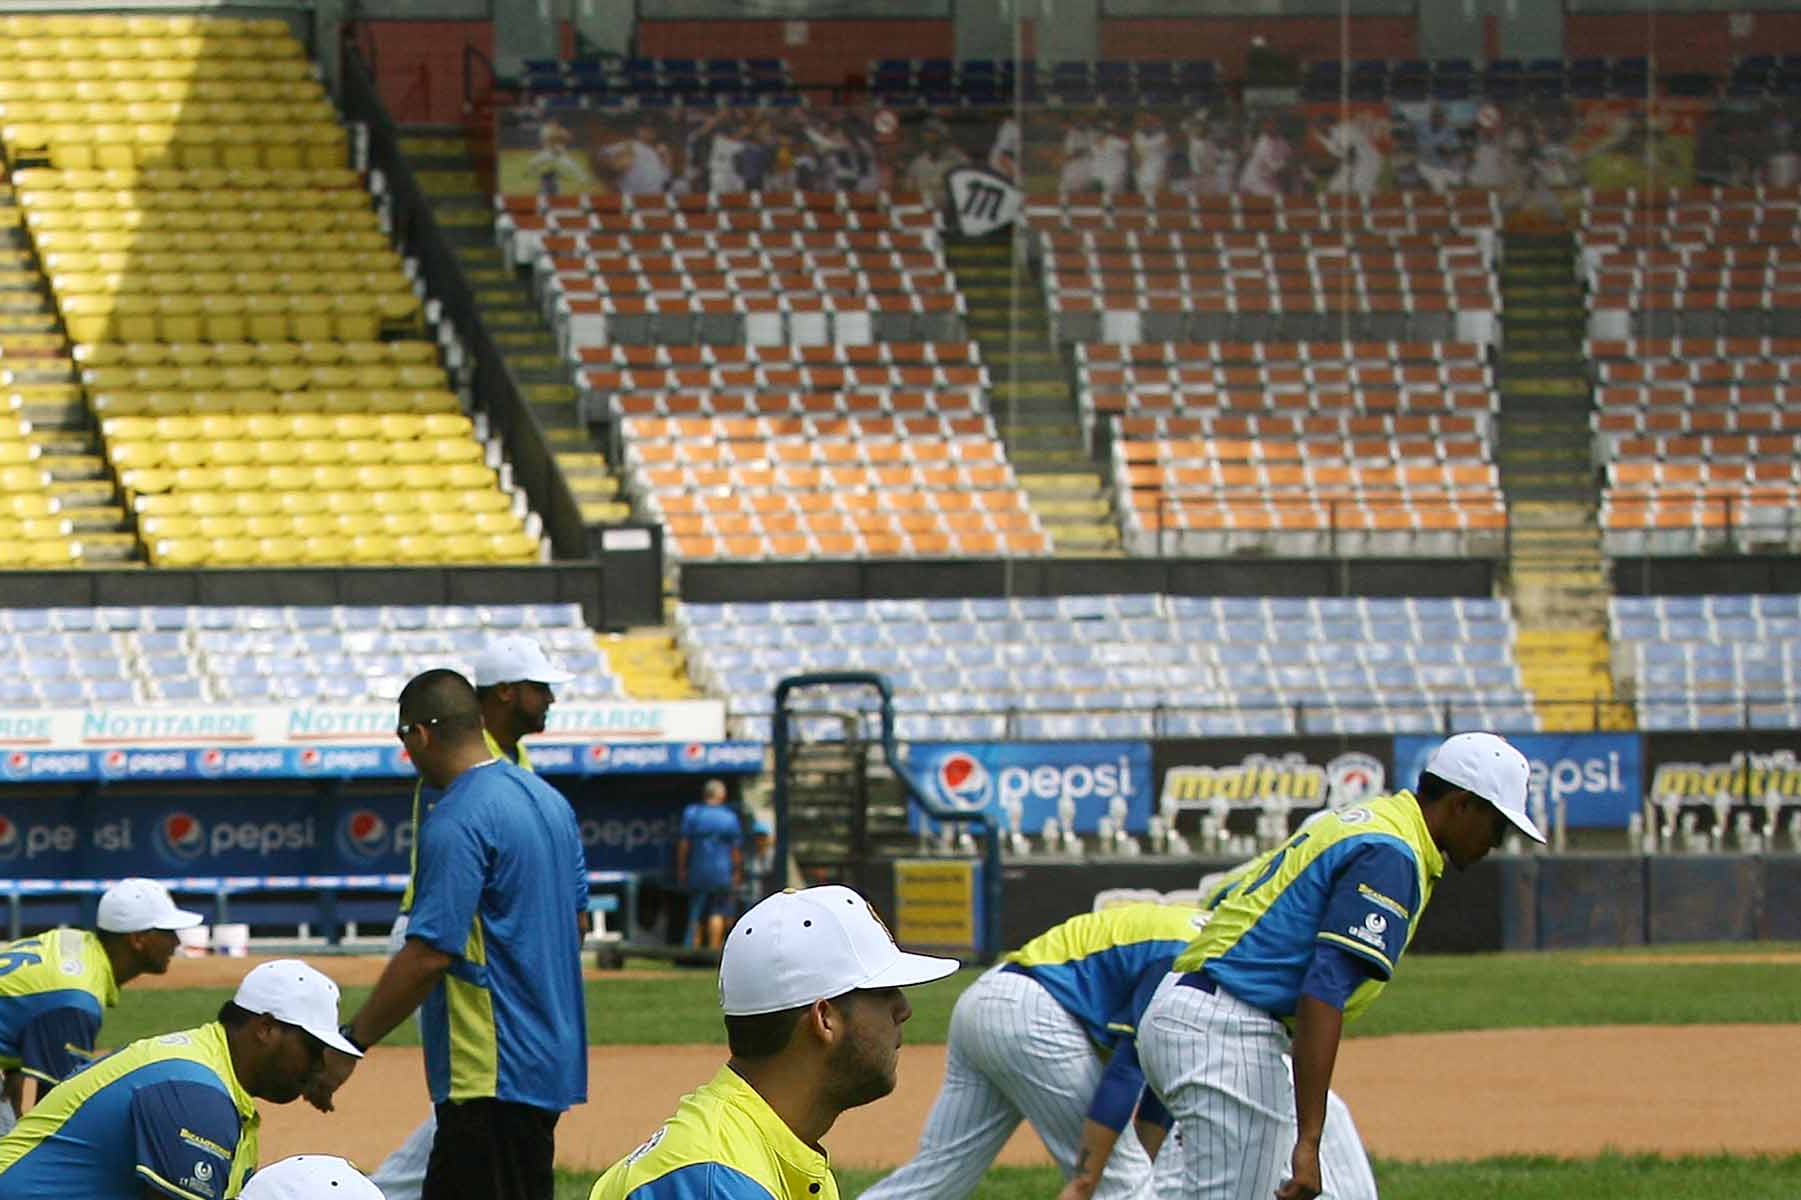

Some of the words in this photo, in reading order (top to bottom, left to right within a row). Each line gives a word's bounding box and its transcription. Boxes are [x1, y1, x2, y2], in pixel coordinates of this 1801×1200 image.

[81, 709, 256, 736] NOTITARDE
[287, 707, 397, 732] NOTITA
[998, 756, 1135, 810] pepsi
[1528, 752, 1624, 800] epsi
[26, 817, 132, 858] pesi
[210, 815, 315, 857] pepsi
